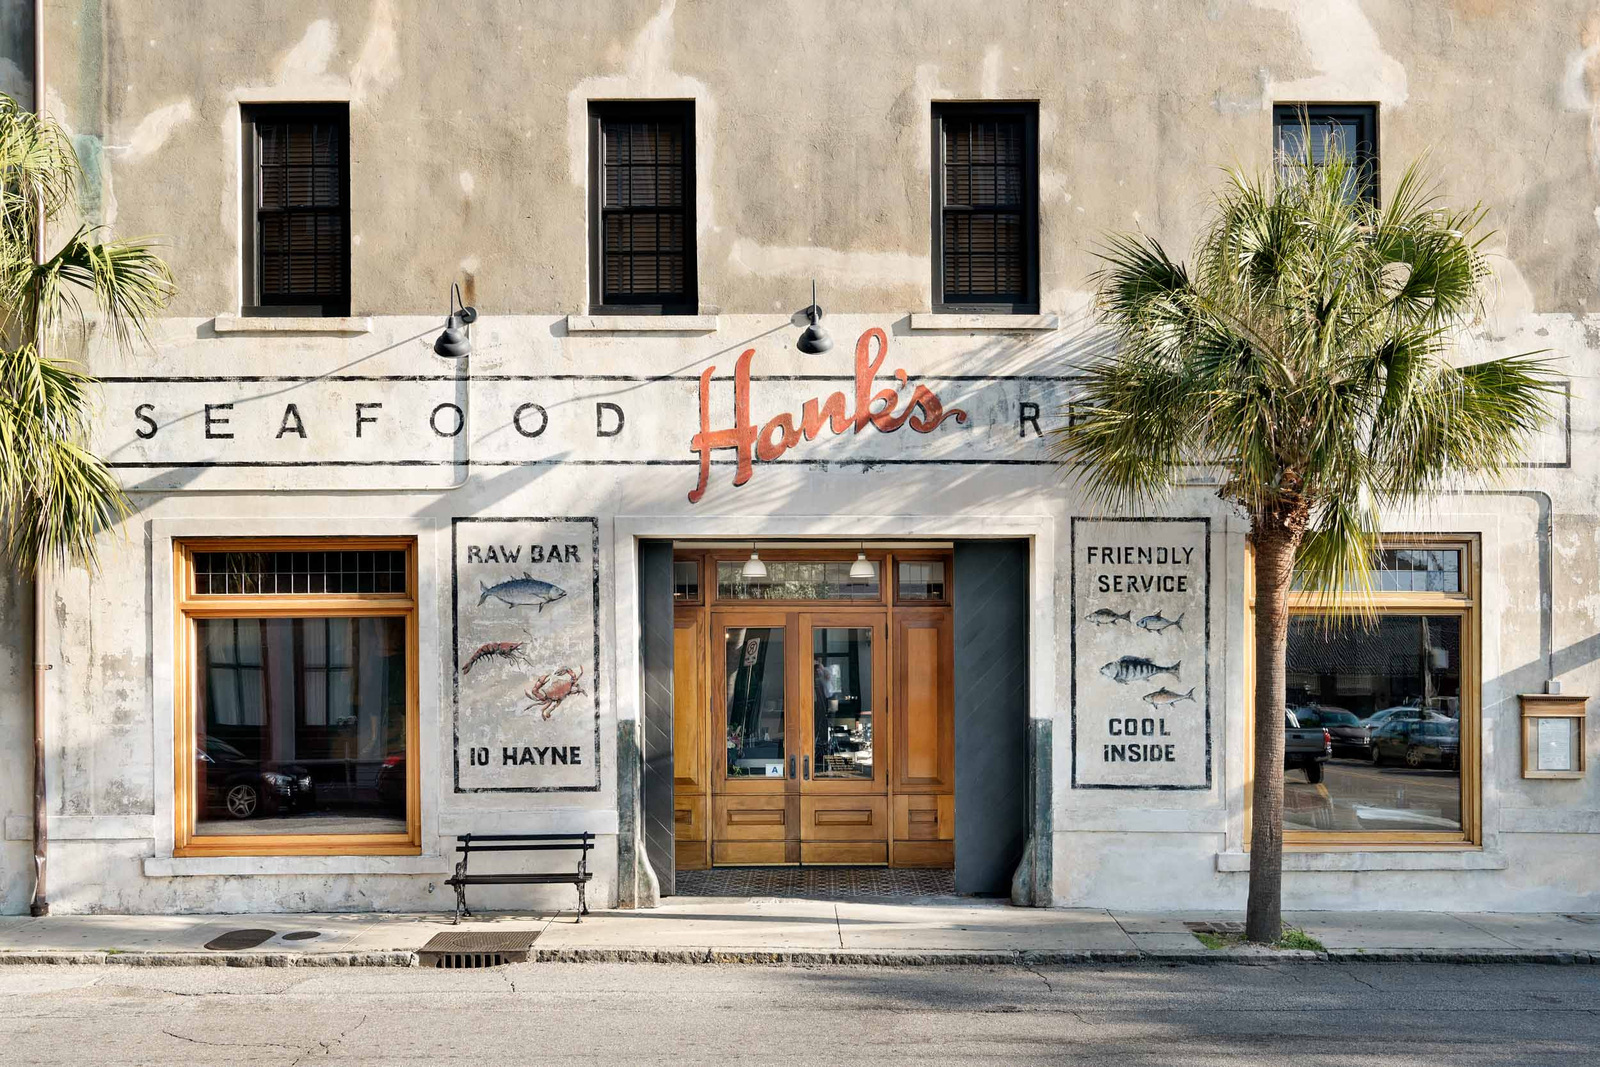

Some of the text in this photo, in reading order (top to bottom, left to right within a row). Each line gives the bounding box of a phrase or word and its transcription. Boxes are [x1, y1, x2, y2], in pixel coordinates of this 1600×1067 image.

[134, 402, 626, 440] SEAFOOD
[687, 327, 967, 504] Hank's
[467, 544, 582, 564] RAW BAR
[1087, 546, 1194, 565] FRIENDLY
[1099, 574, 1188, 593] SERVICE
[1109, 718, 1171, 737] COOL
[470, 746, 582, 766] 10 HAYNE
[1104, 743, 1176, 762] INSIDE
[771, 766, 779, 774] A
